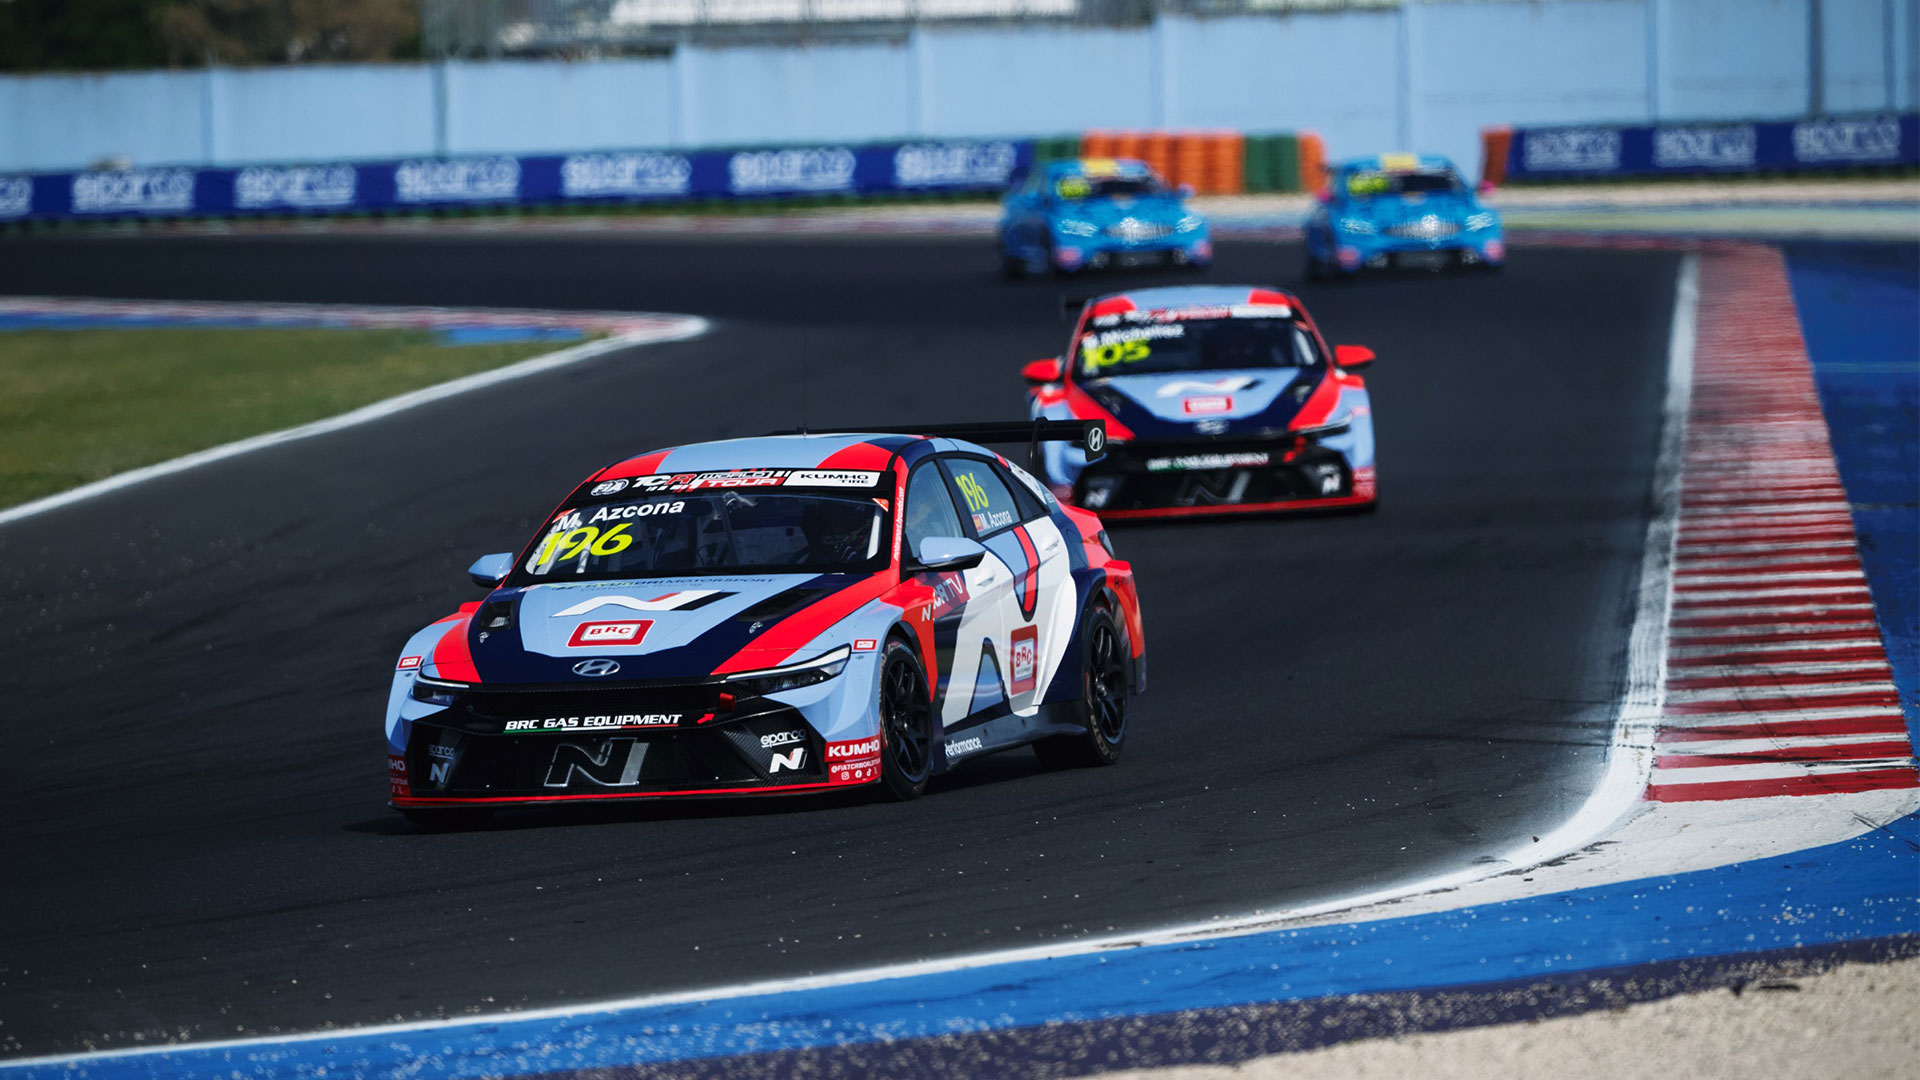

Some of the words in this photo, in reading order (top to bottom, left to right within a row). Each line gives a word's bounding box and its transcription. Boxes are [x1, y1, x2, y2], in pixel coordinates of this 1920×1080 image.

[632, 474, 697, 488] TCR
[707, 479, 778, 487] TOUR
[955, 472, 989, 512] 196
[556, 512, 583, 531] M.
[588, 501, 685, 524] Azcona
[537, 523, 633, 566] 196
[589, 626, 632, 635] BRC
[1016, 646, 1032, 668] BRC
[505, 720, 540, 731] BRC
[544, 717, 579, 728] GAS
[583, 714, 682, 726] EQUIPMENT
[828, 740, 880, 758] KUMHO
